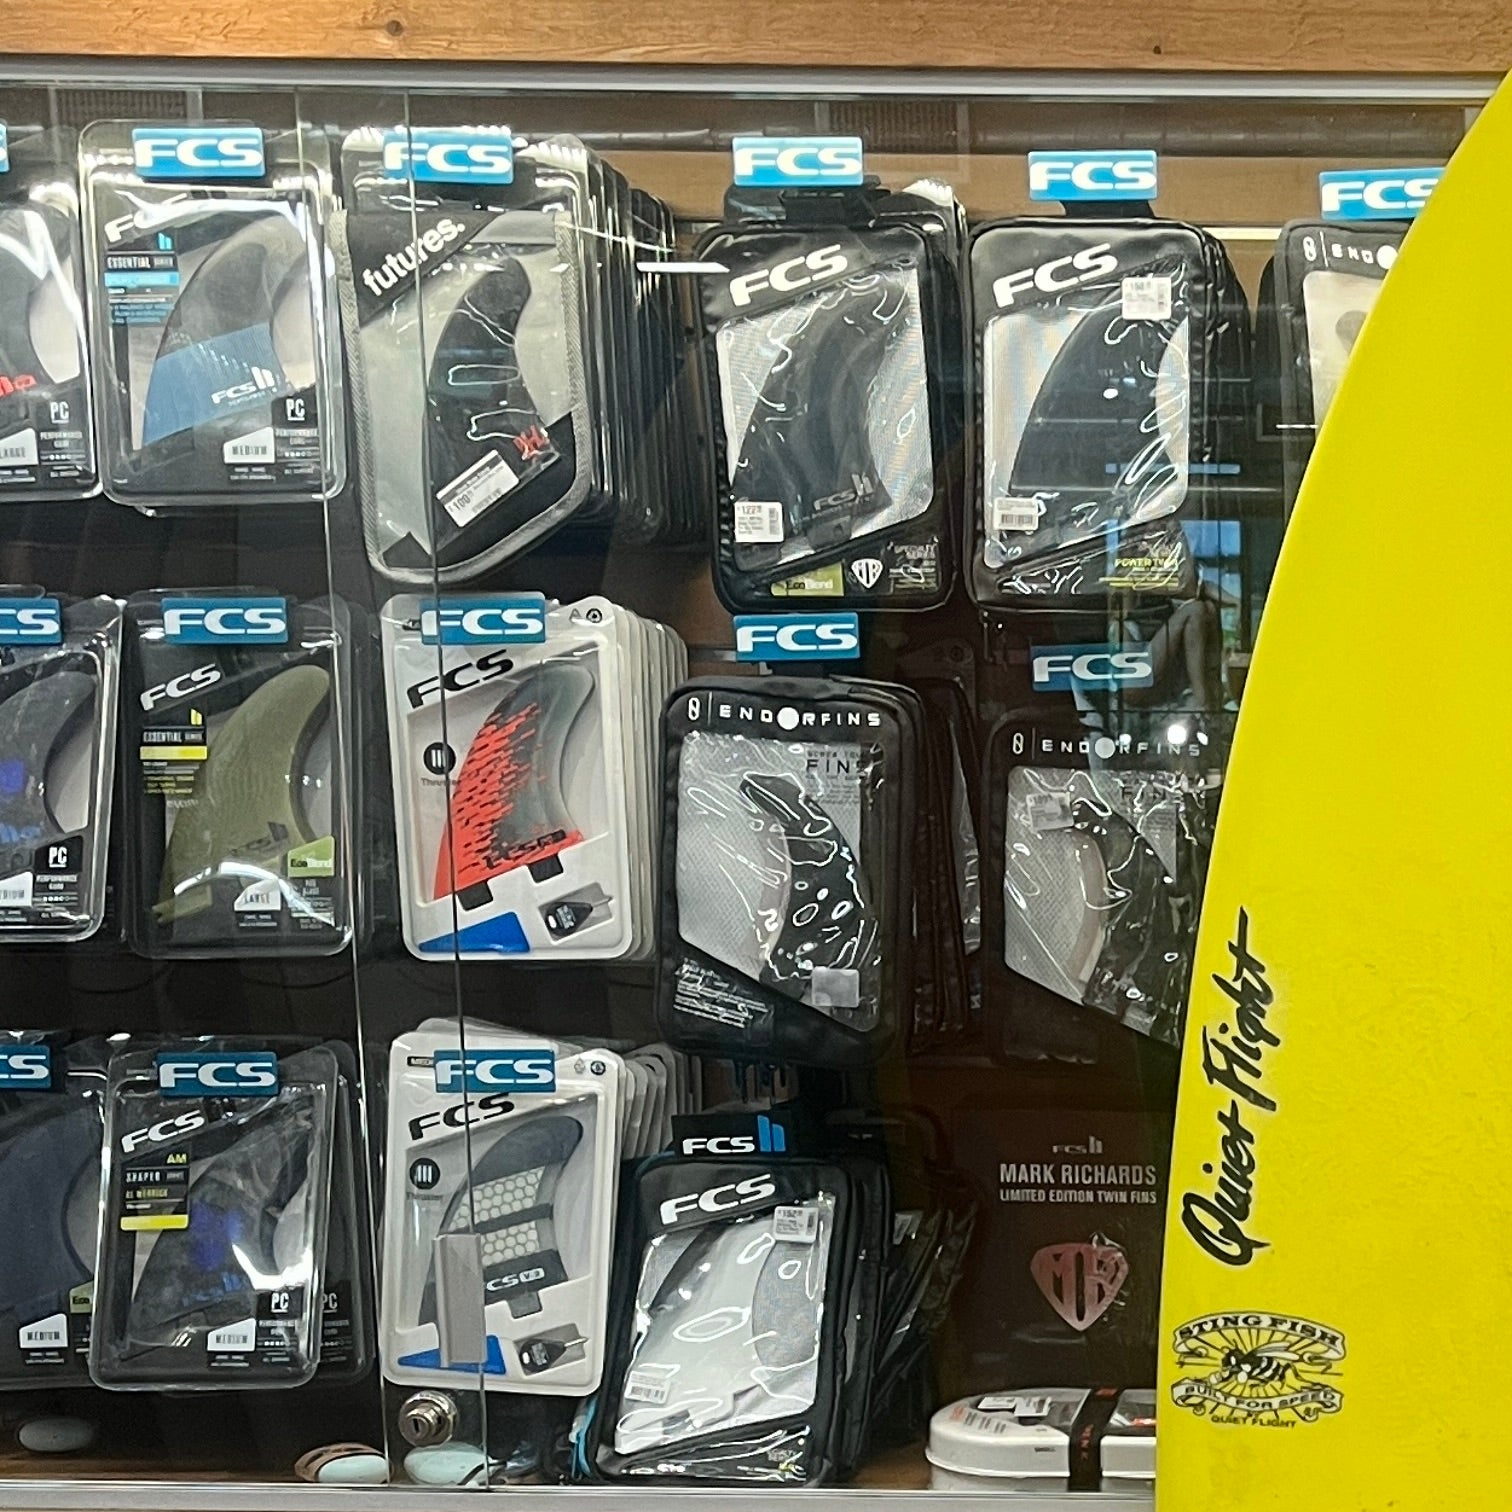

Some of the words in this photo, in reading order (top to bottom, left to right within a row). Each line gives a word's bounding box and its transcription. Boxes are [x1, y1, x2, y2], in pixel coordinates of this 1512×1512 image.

[134, 139, 262, 167] FCS
[384, 140, 511, 174] FCS
[734, 147, 860, 178] FCS
[1030, 160, 1156, 190] FCS
[1322, 179, 1438, 211] FCS
[363, 216, 466, 296] futures.
[730, 244, 850, 306] FCS
[993, 243, 1117, 307] FCS
[211, 381, 257, 404] FCS
[50, 401, 69, 420] PC
[286, 398, 305, 418] PC
[163, 606, 286, 636] FCS
[421, 606, 544, 636] FCS
[736, 624, 858, 652] FCS
[408, 649, 514, 708] FCS
[1032, 654, 1152, 684] FCS
[140, 663, 221, 711] FCS
[719, 704, 881, 731] ENDORFINS
[48, 846, 68, 864] PC
[1202, 905, 1281, 1112] Flight
[158, 1061, 277, 1088] FCS
[436, 1058, 554, 1085] FCS
[121, 1109, 205, 1153] FCS
[408, 1092, 515, 1140] FCS
[166, 1153, 187, 1164] AM
[682, 1136, 755, 1155] FCS
[1000, 1163, 1054, 1185] MARK
[1061, 1164, 1156, 1186] RICHARDS
[1182, 1099, 1272, 1266] Quiet
[660, 1173, 776, 1225] FCS
[1000, 1189, 1045, 1202] LIMITED
[1049, 1189, 1094, 1203] EDITION
[1097, 1190, 1127, 1203] TWIN
[1130, 1191, 1157, 1204] FINS
[486, 1273, 520, 1292] CS
[271, 1292, 289, 1310] PC
[1179, 1315, 1263, 1340] STING
[1270, 1317, 1340, 1346] FISH
[1235, 1400, 1273, 1410] FOR
[1278, 1390, 1336, 1408] SPEED
[1211, 1414, 1248, 1424] QUIET
[1251, 1417, 1297, 1429] FLIGHT
